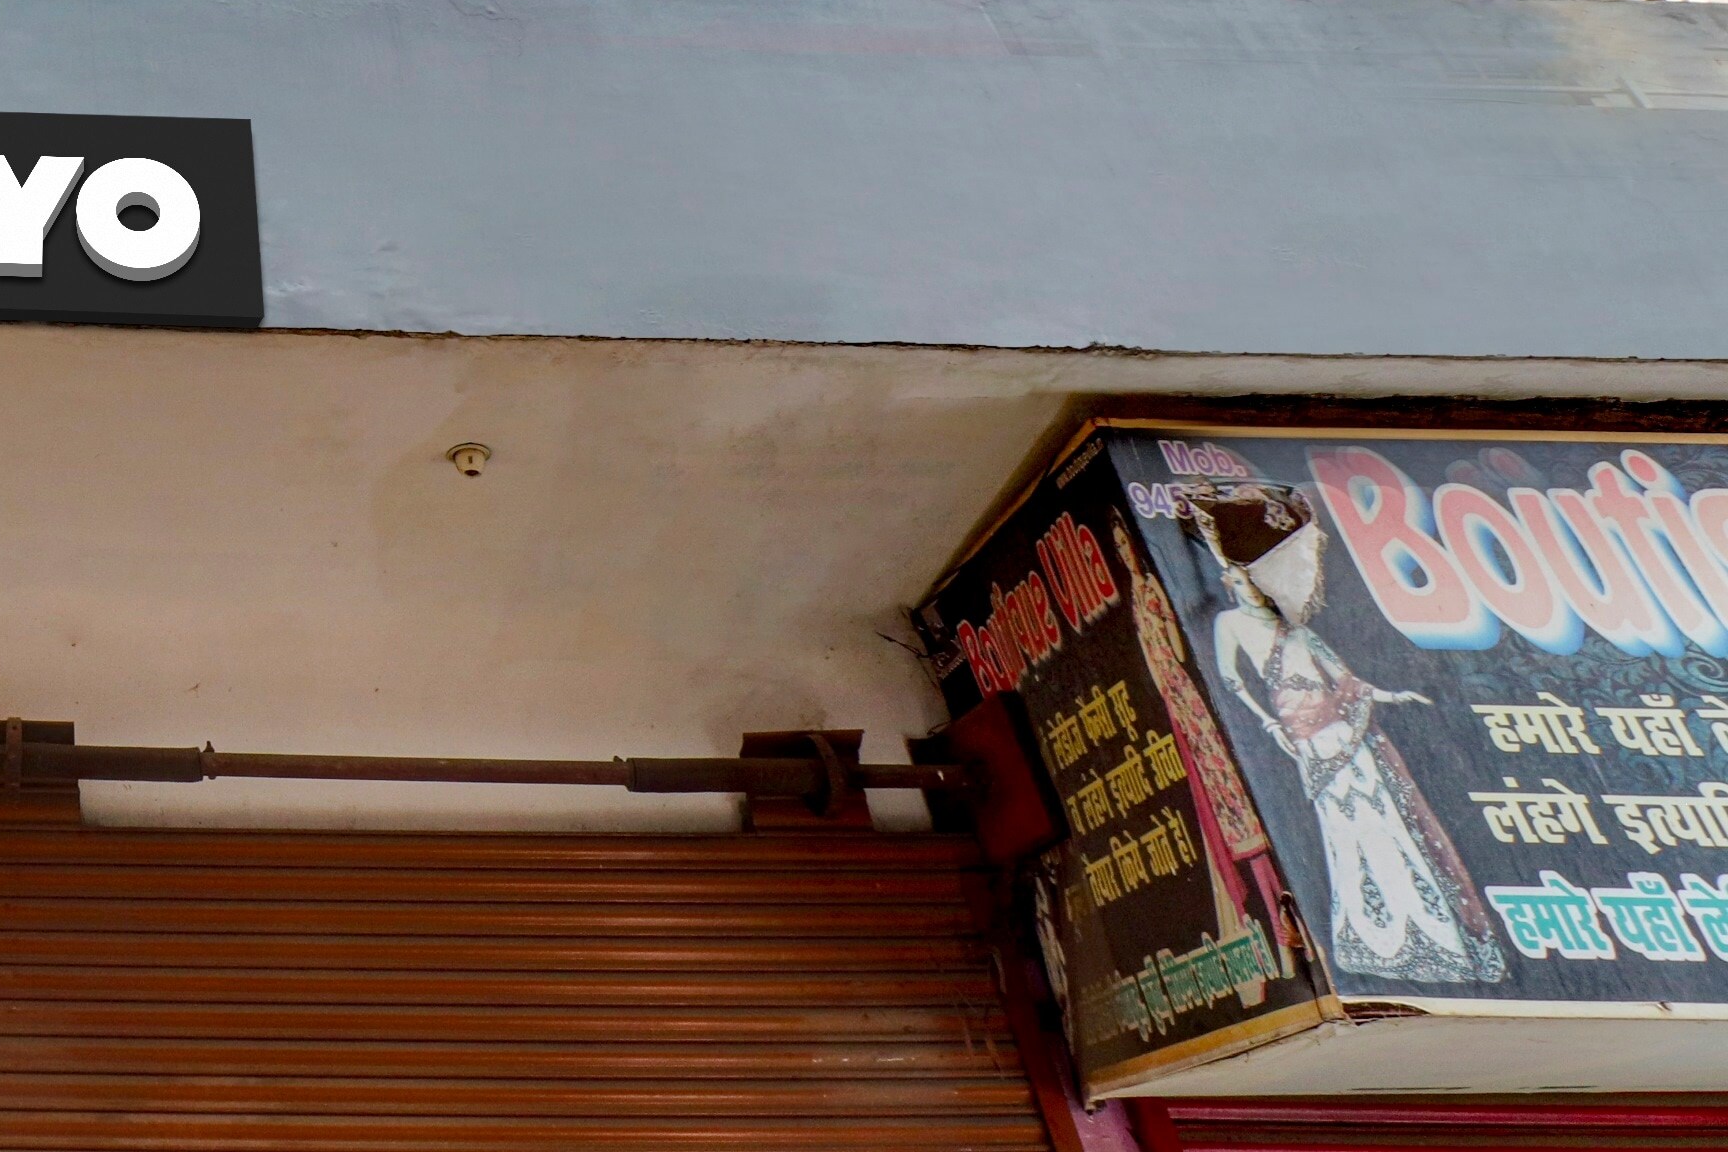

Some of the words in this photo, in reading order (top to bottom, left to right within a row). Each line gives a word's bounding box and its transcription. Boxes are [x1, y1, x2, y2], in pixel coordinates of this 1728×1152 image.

[1158, 439, 1247, 477] Mob.
[1036, 511, 1121, 635] Villa
[1469, 691, 1602, 755] हमारे
[1593, 694, 1706, 757] यहाँ
[1468, 776, 1610, 845] लंहगे
[1485, 870, 1616, 960] हमारे
[1591, 871, 1707, 962] यहाँ
